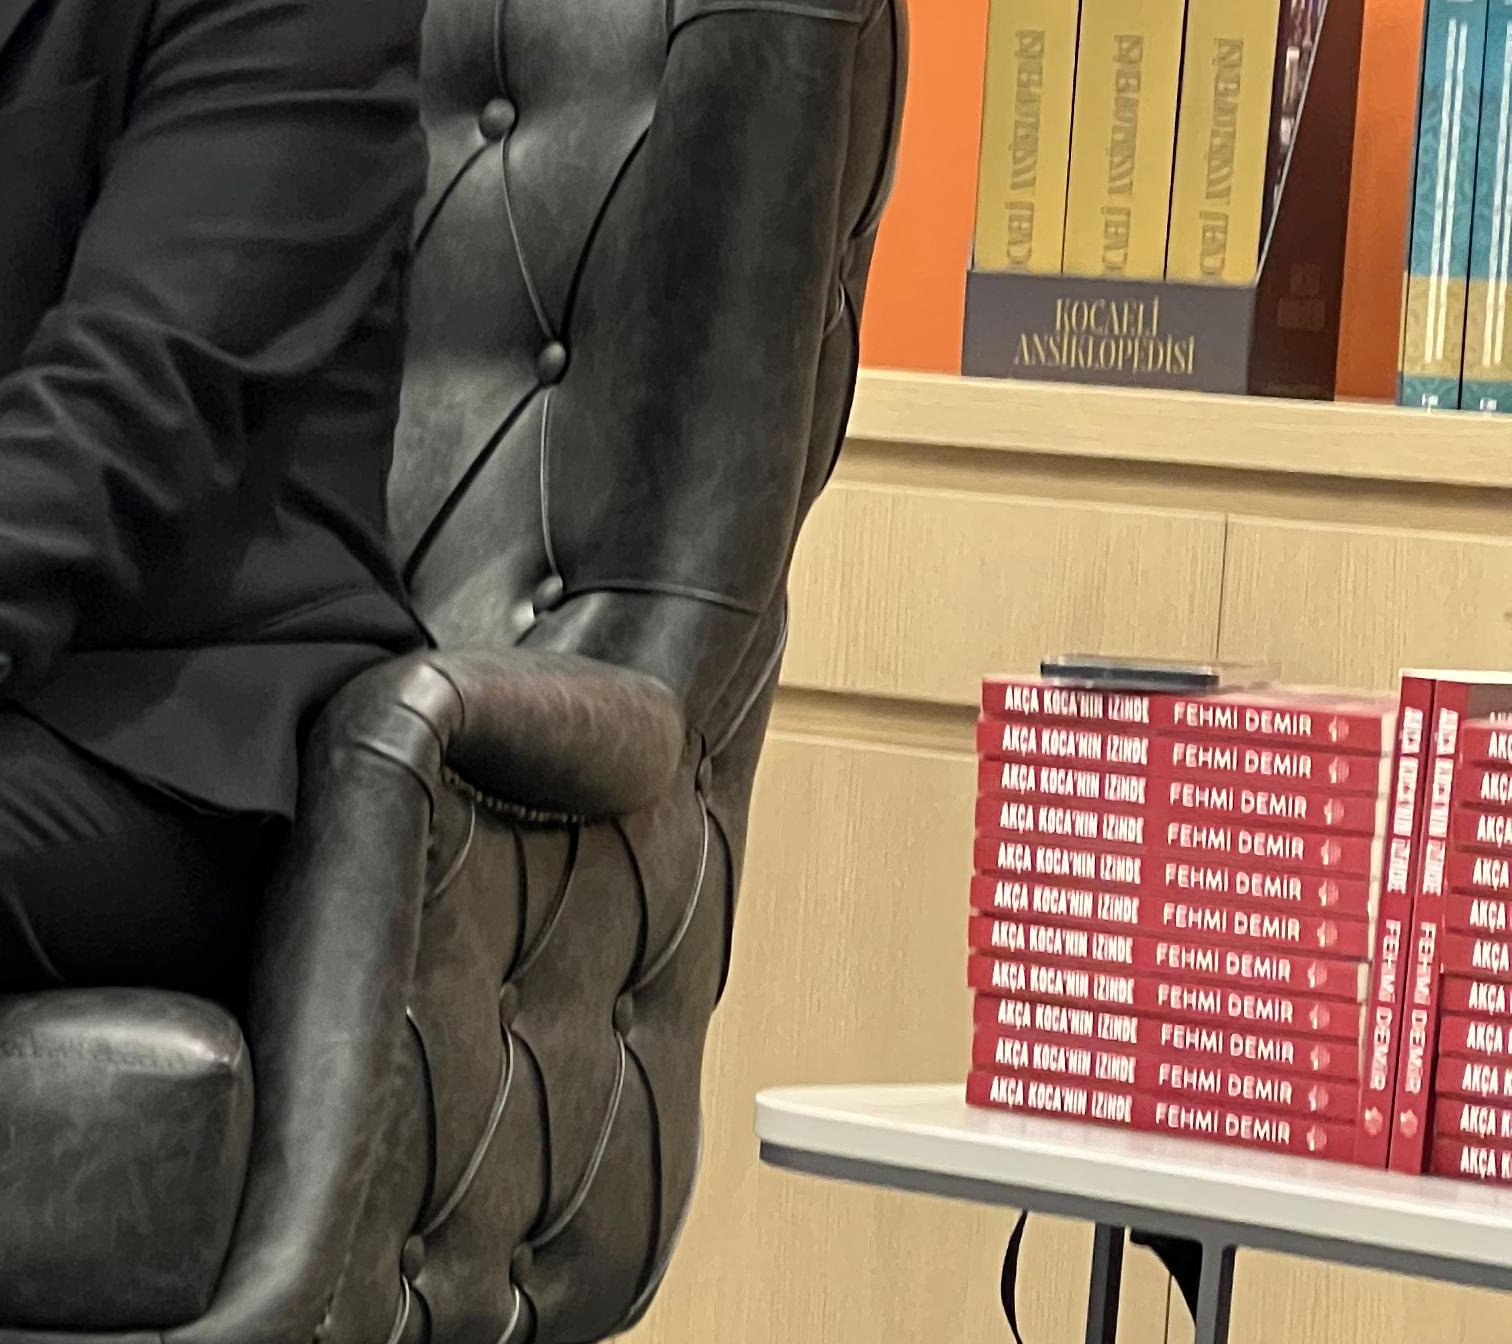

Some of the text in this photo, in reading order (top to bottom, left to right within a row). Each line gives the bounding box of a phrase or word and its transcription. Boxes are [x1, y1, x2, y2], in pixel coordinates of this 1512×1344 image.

[1003, 684, 1040, 716] AKÇA
[1001, 723, 1037, 757] AKÇA
[1001, 762, 1036, 795] AKÇA
[999, 801, 1035, 835] AKÇA
[997, 841, 1032, 874] AKÇA
[1472, 856, 1510, 891] AKÇA
[993, 879, 1029, 913] AKÇA
[1468, 898, 1507, 934] AKÇA
[991, 920, 1026, 953] AKÇA
[1471, 938, 1510, 975] AKÇA
[991, 959, 1026, 994] AKÇA
[997, 998, 1032, 1031] AKÇA
[1468, 981, 1506, 1016] AKÇA
[995, 1036, 1029, 1070] AKÇA
[1466, 1021, 1503, 1056] AKÇA
[989, 1075, 1024, 1109] AKÇA
[1461, 1062, 1499, 1098] AKÇA
[1459, 1103, 1496, 1139] AKÇA
[1459, 1145, 1497, 1179] AKÇA
